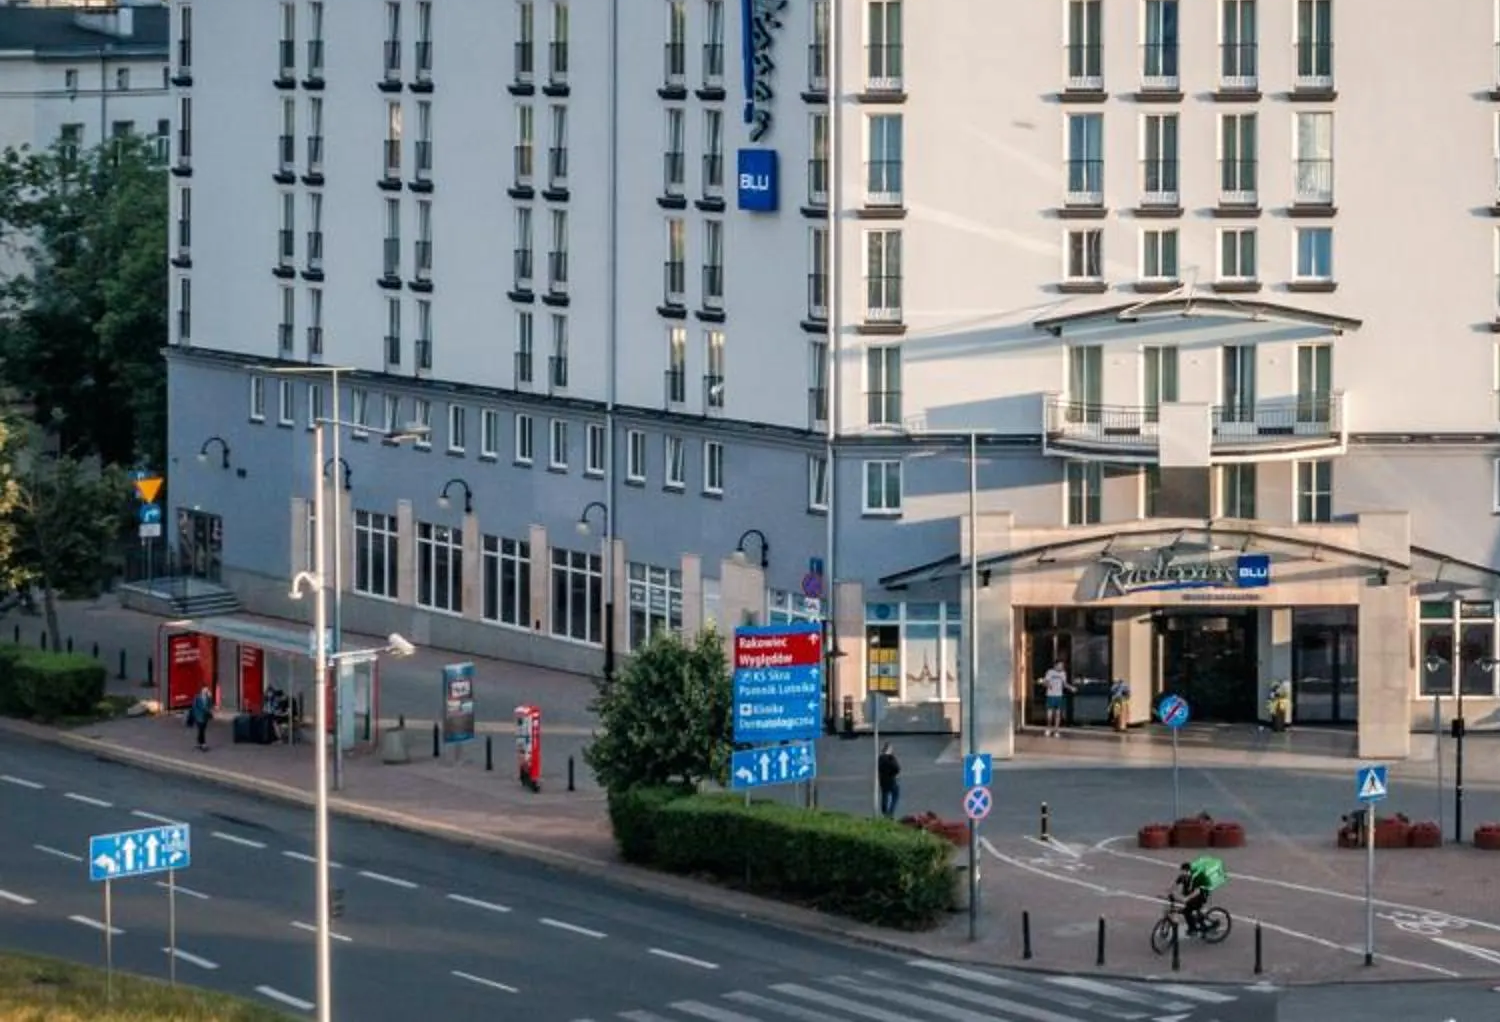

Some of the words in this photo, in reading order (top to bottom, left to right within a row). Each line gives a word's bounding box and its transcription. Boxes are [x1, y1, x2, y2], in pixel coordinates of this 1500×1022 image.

[740, 173, 769, 191] BLU
[1239, 566, 1268, 578] BLU
[739, 637, 788, 649] Rakowiec
